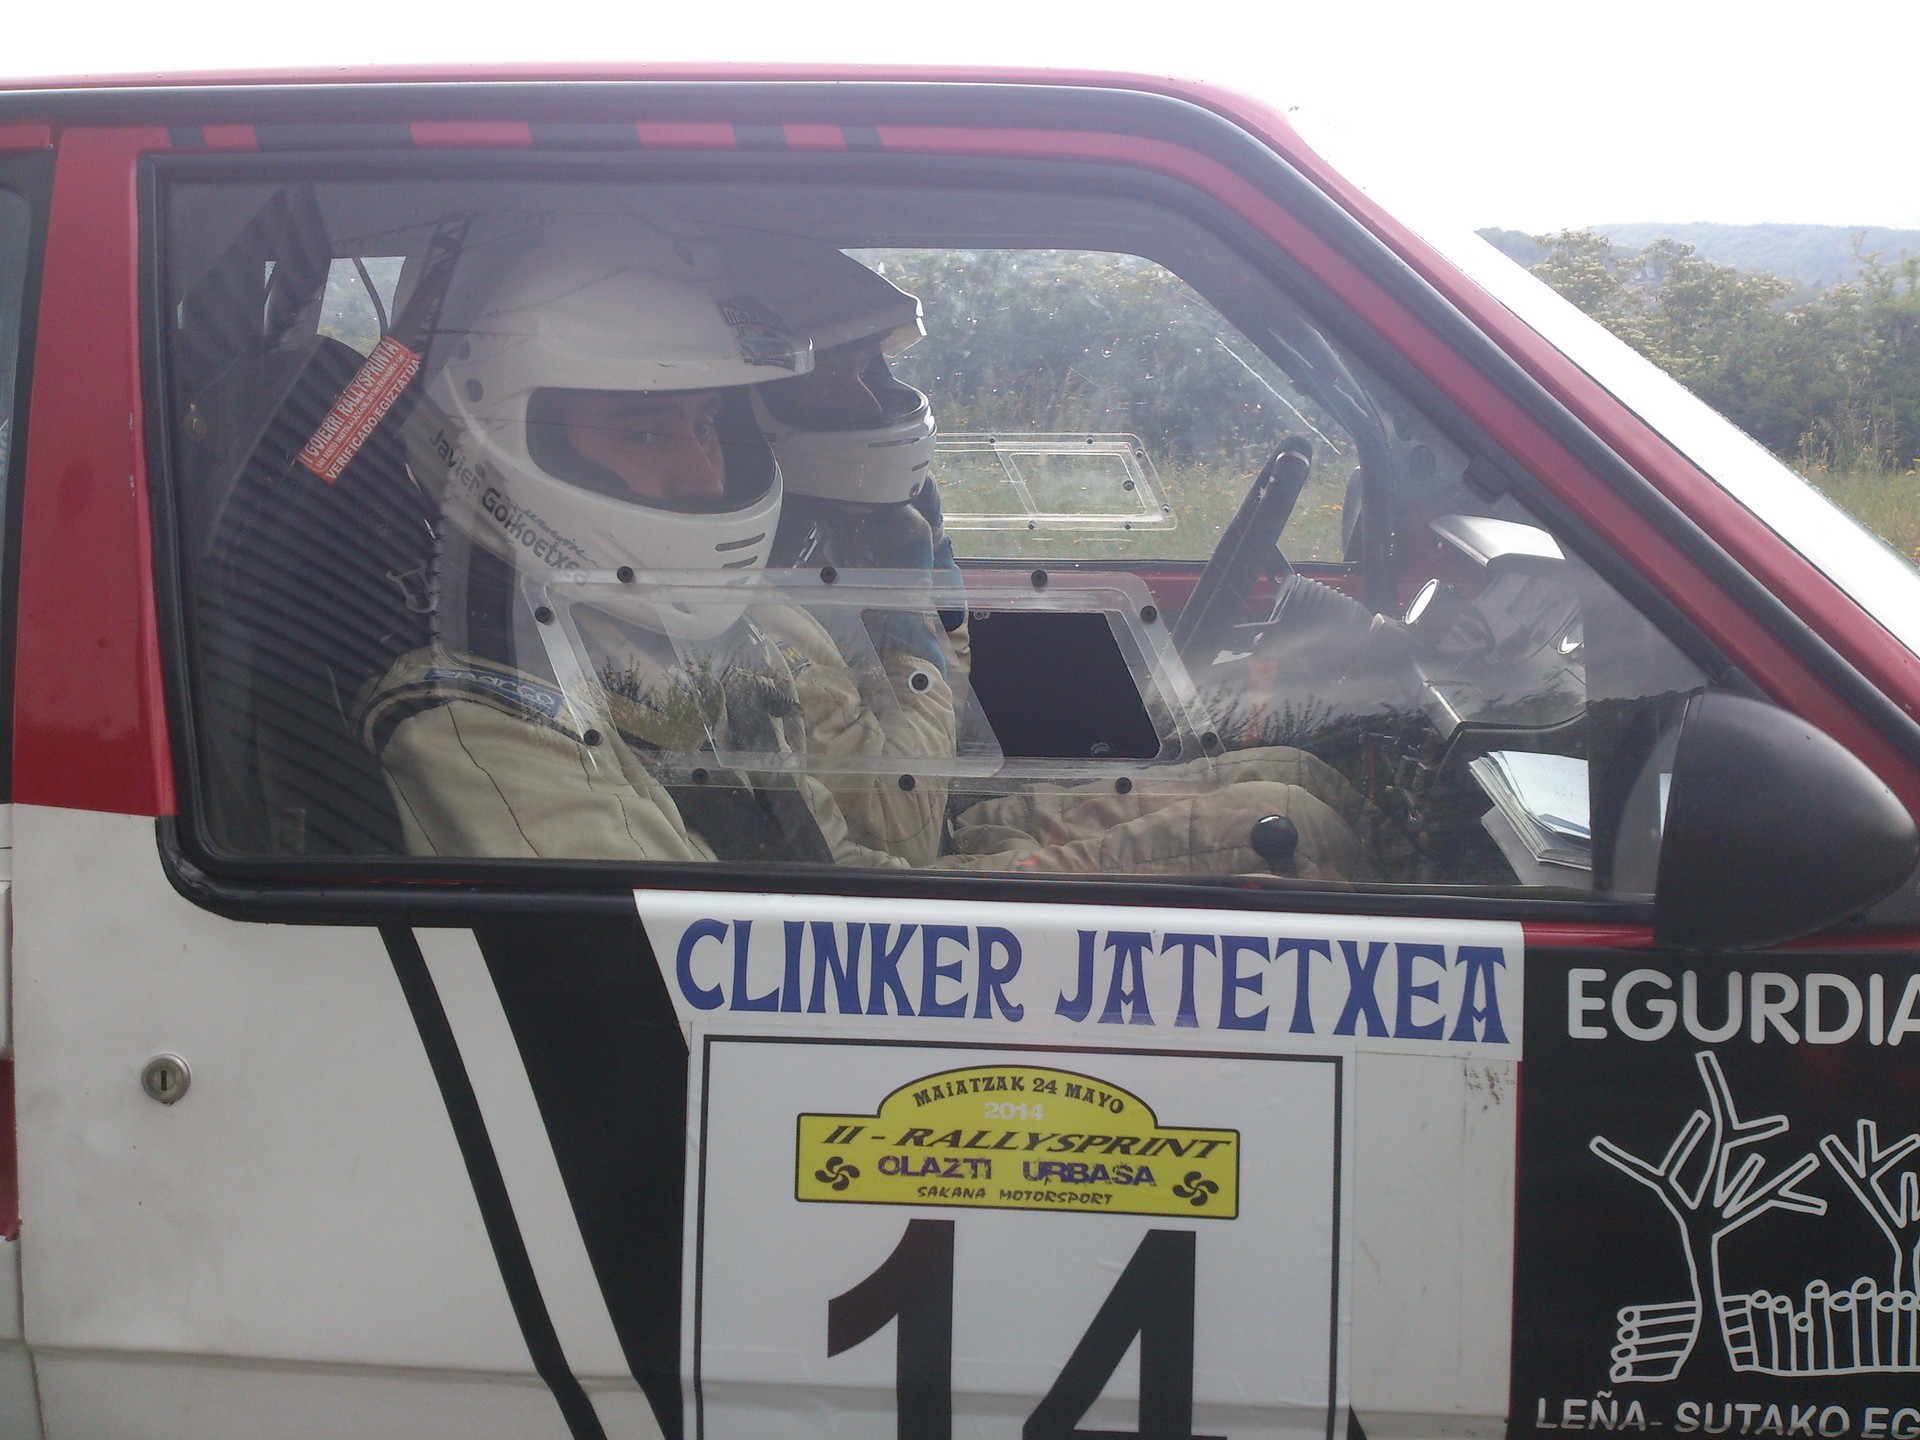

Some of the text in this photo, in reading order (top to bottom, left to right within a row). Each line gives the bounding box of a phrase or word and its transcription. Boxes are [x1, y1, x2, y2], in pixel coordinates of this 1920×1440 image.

[302, 410, 345, 459] GOIERRI
[333, 338, 399, 417] RALLYSPRINTA
[326, 358, 422, 481] VERIFICADO/EGIZTATUA
[675, 919, 1511, 1044] CLINKER JATETXEA
[983, 1101, 1045, 1121] 2014
[1032, 1077, 1058, 1095] 24
[1065, 1083, 1124, 1114] MAYO
[892, 1128, 1231, 1159] RALLYSPRINT
[877, 1155, 1157, 1187] OLAZTI URBASA
[917, 1186, 1114, 1206] SAKANA MOTORSPORT
[827, 1218, 1227, 1440] 14
[1674, 1401, 1850, 1438] SUTAKO
